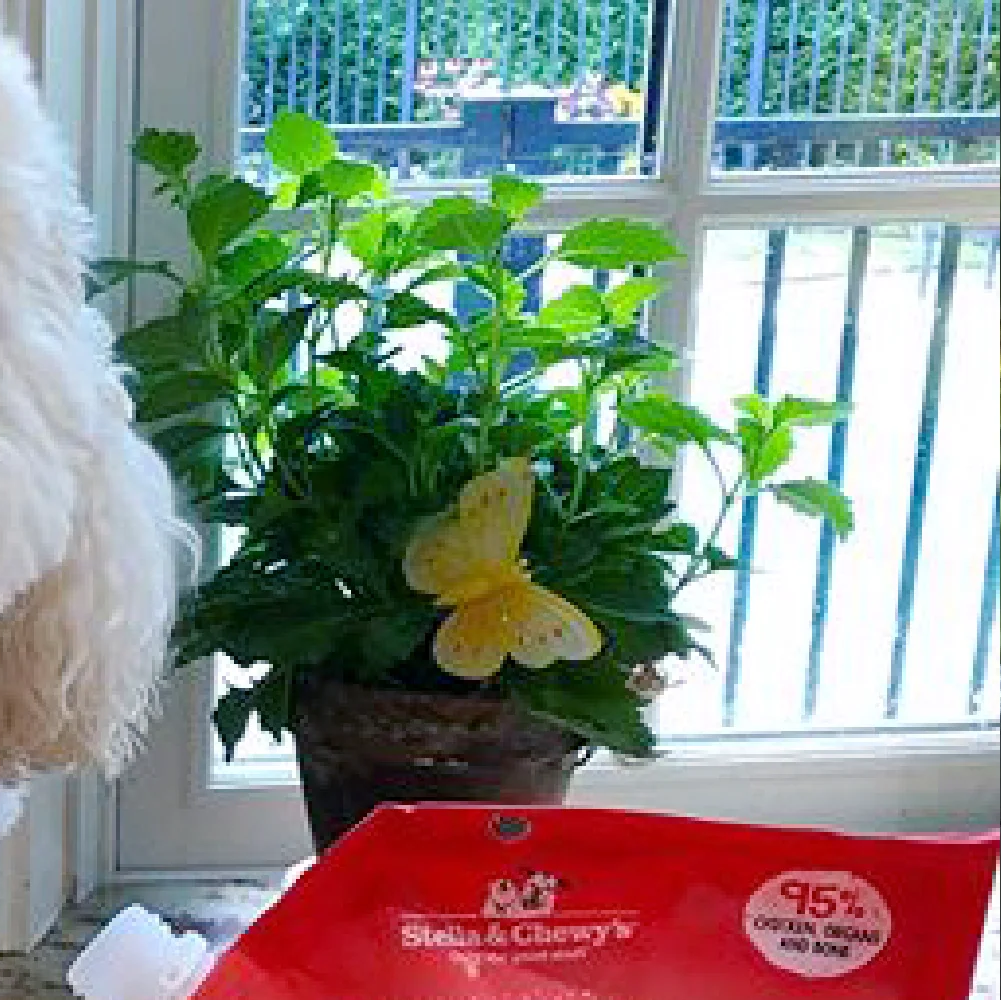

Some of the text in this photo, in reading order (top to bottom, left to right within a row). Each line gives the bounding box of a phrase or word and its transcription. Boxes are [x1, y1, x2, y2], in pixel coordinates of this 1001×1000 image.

[780, 879, 865, 920] 95%
[400, 923, 480, 949] Stella
[780, 937, 850, 958] AND BONE
